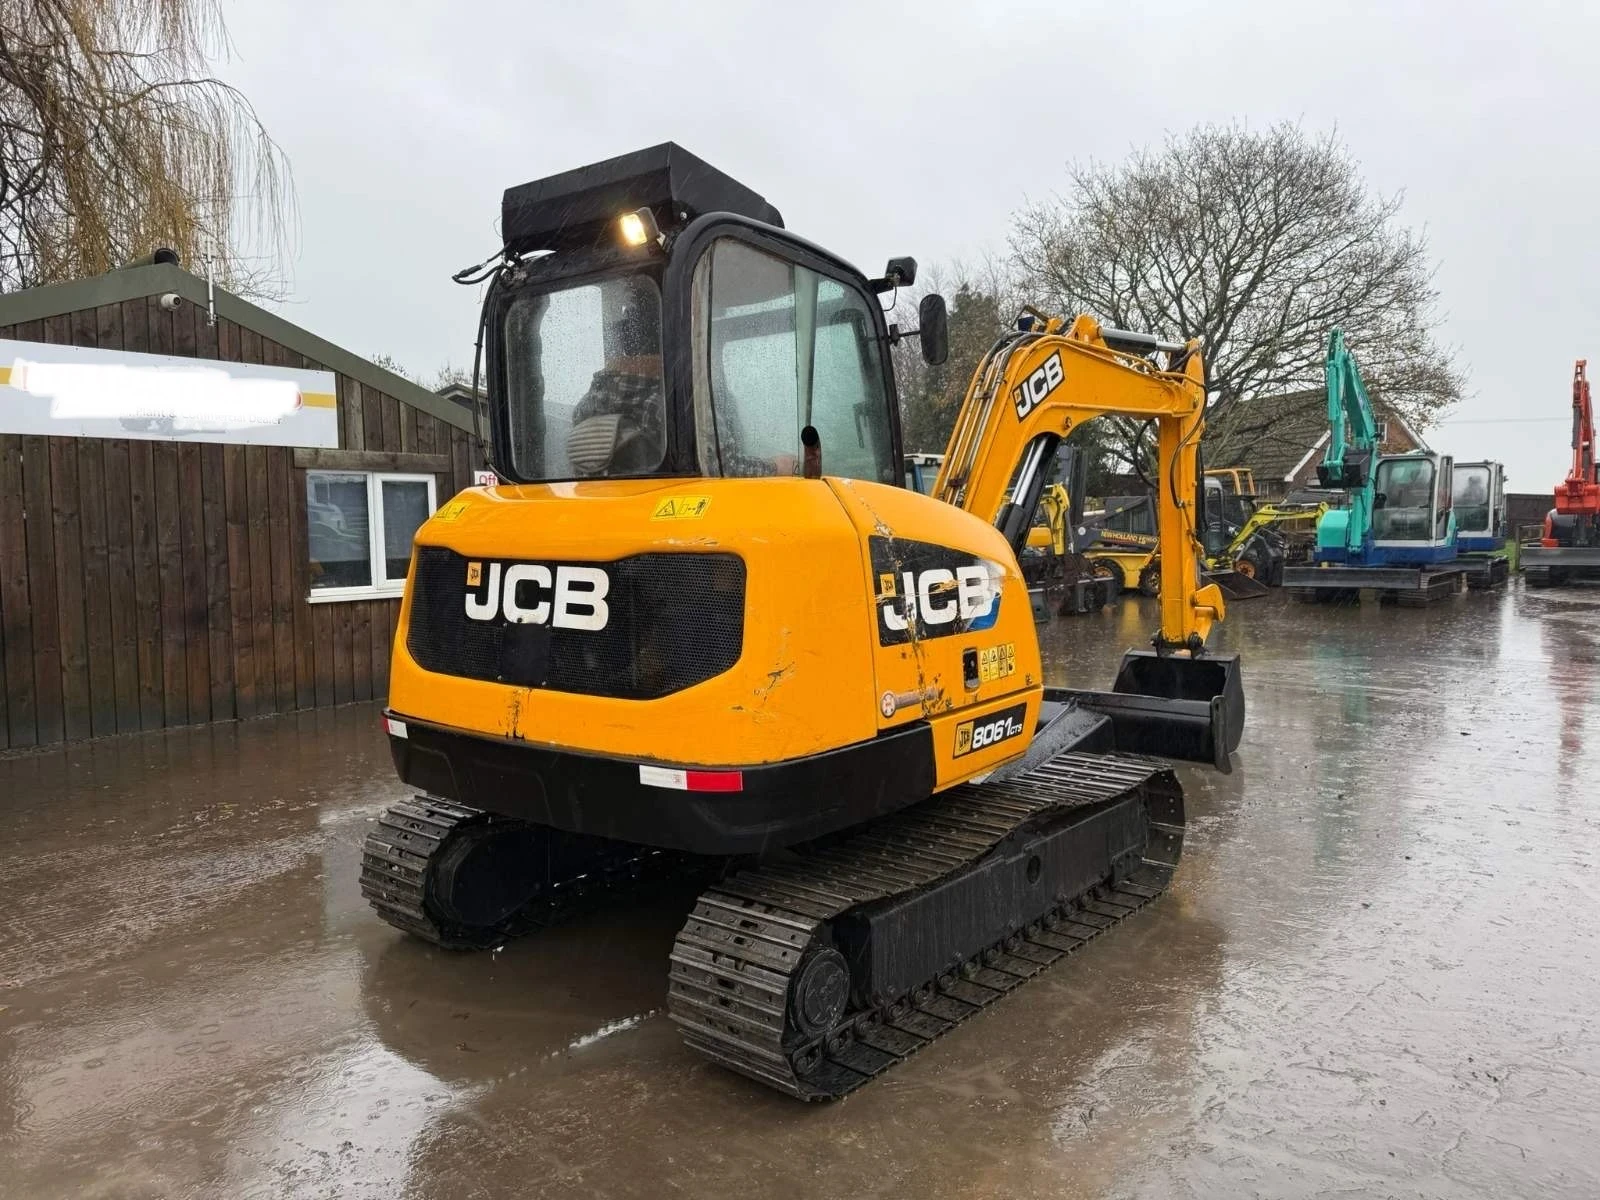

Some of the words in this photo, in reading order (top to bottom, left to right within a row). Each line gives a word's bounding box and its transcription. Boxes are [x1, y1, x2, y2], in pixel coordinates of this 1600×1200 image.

[1017, 354, 1063, 418] JCB
[465, 563, 609, 631] JCB
[883, 566, 992, 630] JCB
